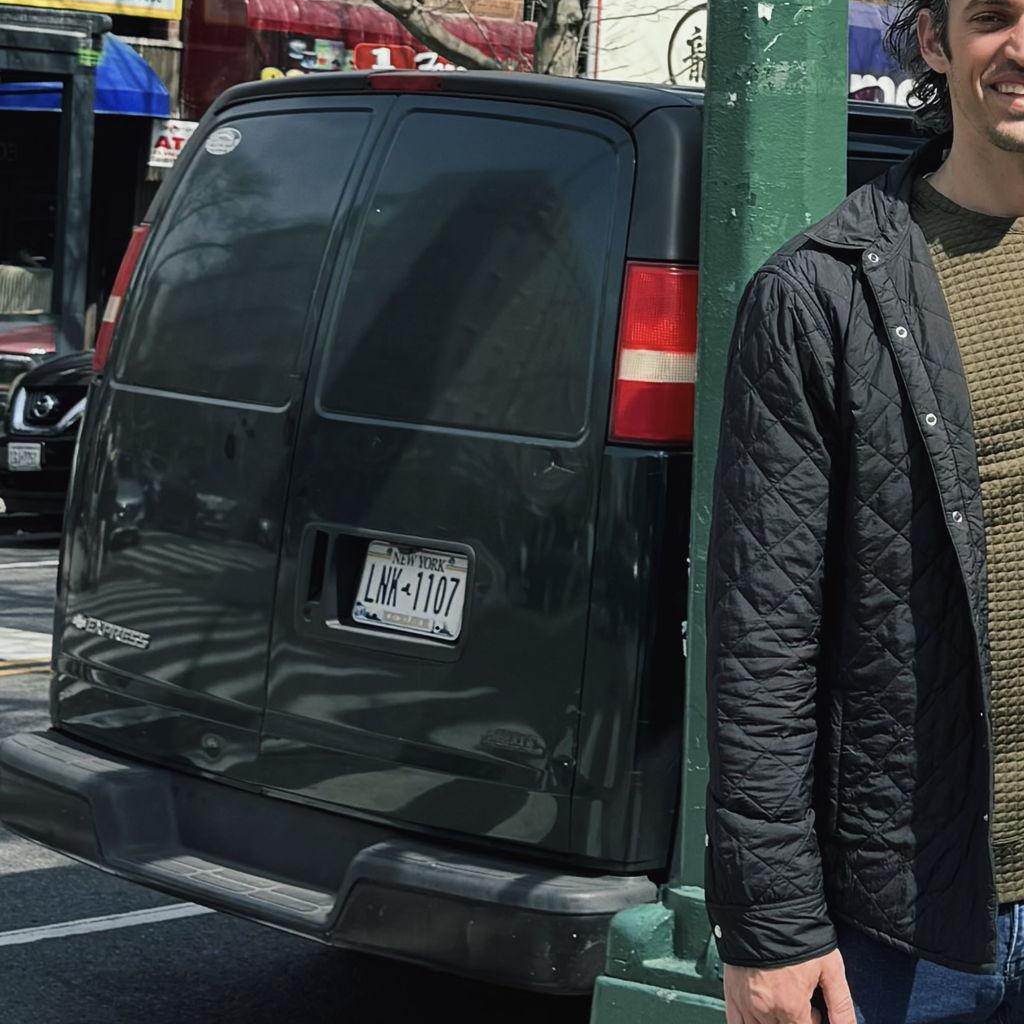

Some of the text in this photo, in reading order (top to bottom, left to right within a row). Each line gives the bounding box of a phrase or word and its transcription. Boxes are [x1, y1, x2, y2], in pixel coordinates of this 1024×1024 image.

[154, 136, 186, 151] AT
[392, 551, 447, 573] NEW YORK
[86, 616, 150, 649] EXPRESS
